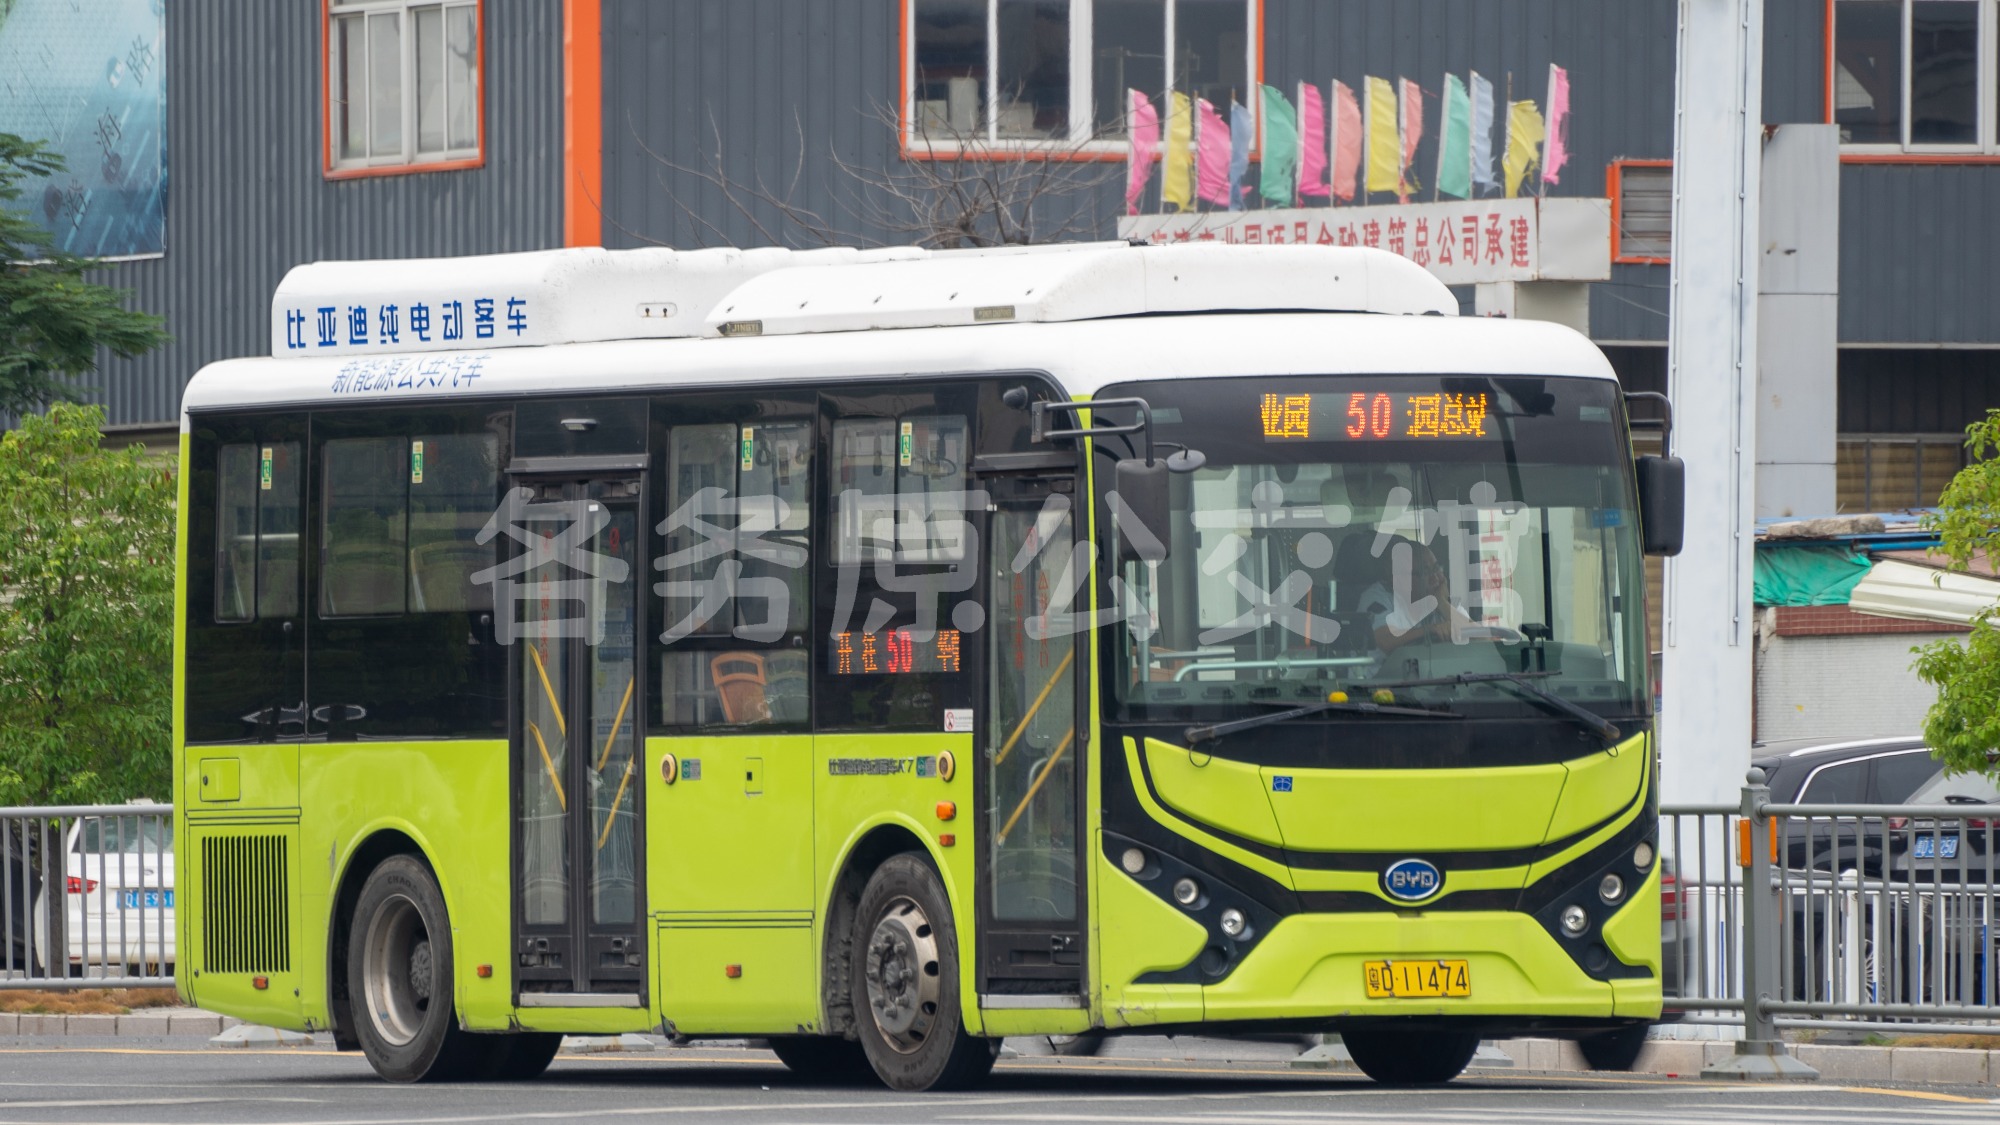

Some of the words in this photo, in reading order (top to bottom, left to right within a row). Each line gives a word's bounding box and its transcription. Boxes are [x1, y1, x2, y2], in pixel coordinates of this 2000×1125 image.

[286, 296, 528, 349] 比亚迪纯电动客车
[331, 354, 493, 394] 新能源公共汽车
[1347, 393, 1391, 438] 50
[887, 630, 912, 673] 50
[1392, 870, 1434, 888] BYD
